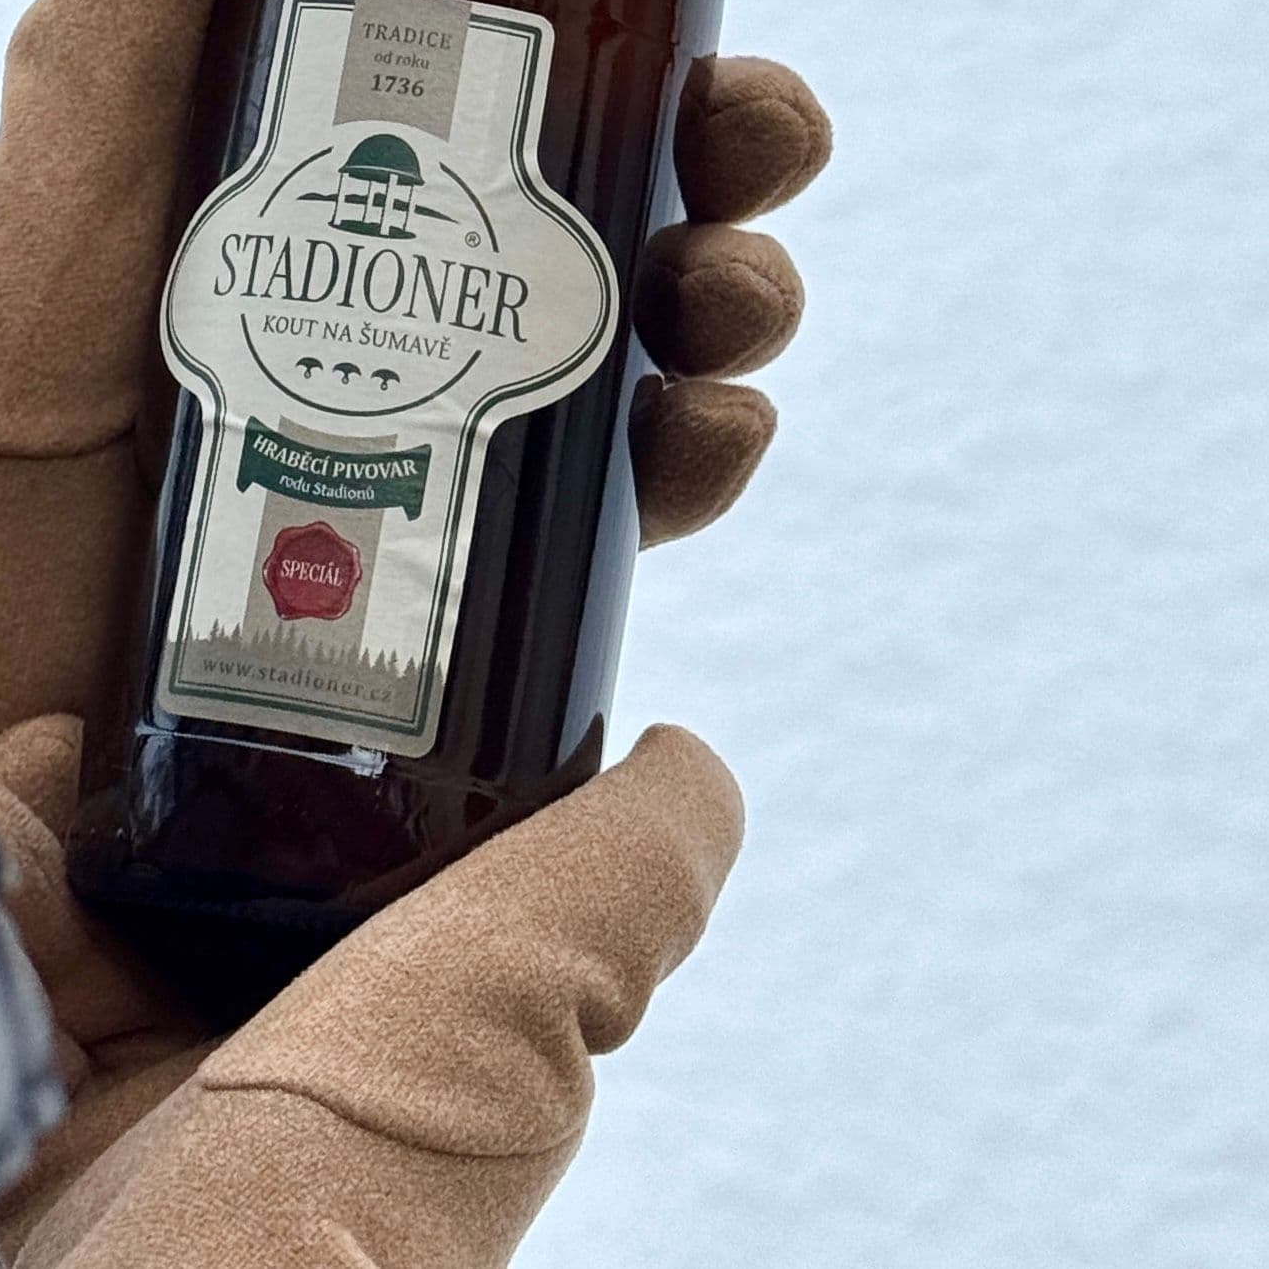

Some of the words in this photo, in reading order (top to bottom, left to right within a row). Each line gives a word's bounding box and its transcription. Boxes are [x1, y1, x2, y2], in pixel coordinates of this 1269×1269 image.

[362, 22, 453, 50] TRADICE
[374, 49, 392, 65] od
[395, 51, 431, 71] roku
[370, 73, 425, 98] 1736
[213, 232, 529, 343] STADIONER
[262, 314, 319, 339] KOUT
[322, 320, 354, 343] NA
[359, 321, 453, 361] ŠUMAVĚ
[252, 433, 330, 477] HRABĚCÍ
[332, 458, 419, 480] PIVOVAR
[279, 473, 311, 494] rodu
[312, 480, 376, 501] Stadionů
[280, 559, 344, 587] SPECIÁL
[202, 657, 393, 704] www.stadioner.cz
